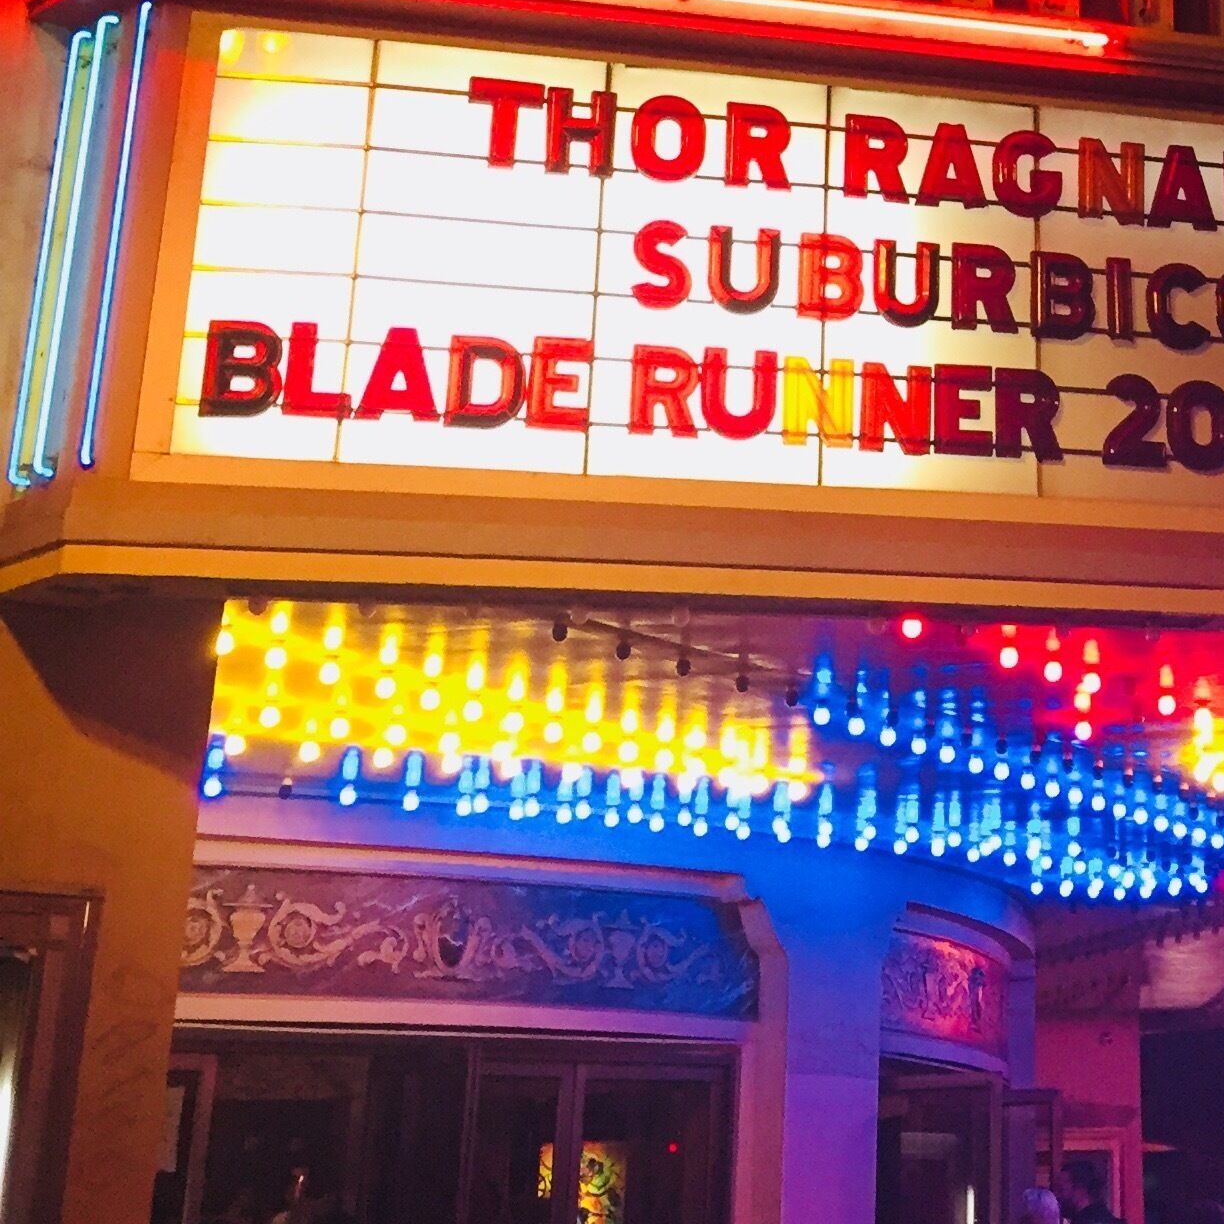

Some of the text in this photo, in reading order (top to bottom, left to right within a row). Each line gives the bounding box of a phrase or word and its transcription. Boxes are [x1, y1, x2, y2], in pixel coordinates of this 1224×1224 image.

[469, 76, 793, 191] THOR
[198, 319, 594, 432] BLADE
[627, 343, 1064, 462] RUNNER
